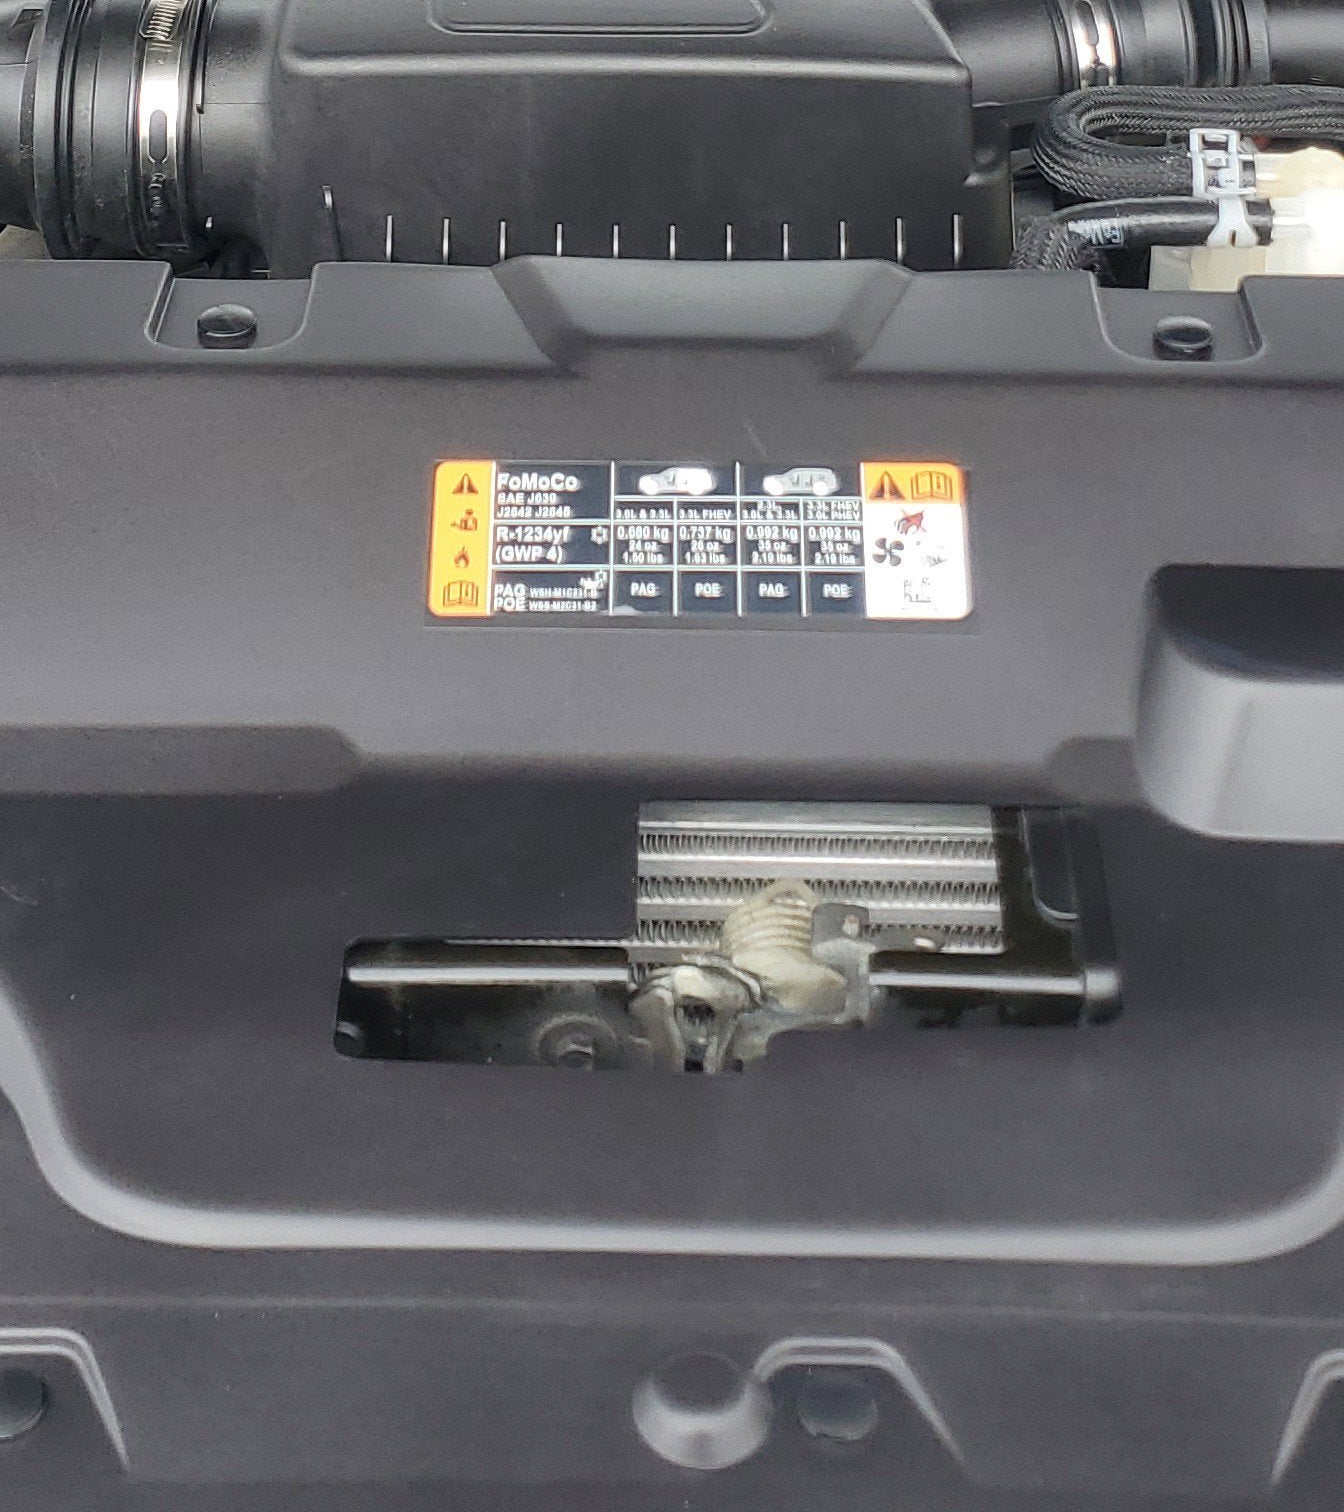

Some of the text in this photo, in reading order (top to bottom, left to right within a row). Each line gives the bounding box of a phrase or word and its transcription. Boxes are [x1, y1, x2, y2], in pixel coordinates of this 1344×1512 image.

[497, 472, 579, 491] FoMoCo
[497, 492, 525, 504] SAE
[496, 526, 570, 545] R-1234yf
[653, 526, 670, 543] kg
[715, 526, 732, 543] kg
[782, 526, 798, 543] kg
[844, 526, 860, 544] kg
[644, 541, 658, 552] oz
[706, 541, 720, 552] oz
[773, 542, 787, 552] oz
[836, 543, 850, 553] oz
[495, 545, 563, 564] (GWP 4)
[647, 552, 664, 564] lbs
[709, 552, 726, 564] lbs
[776, 552, 793, 565] lbs
[839, 553, 856, 565] lbs
[495, 583, 526, 597] PAG
[631, 582, 657, 597] PAG
[695, 582, 722, 597] POE
[759, 583, 784, 598] PAG
[823, 583, 849, 598] POE
[494, 596, 526, 612] POE
